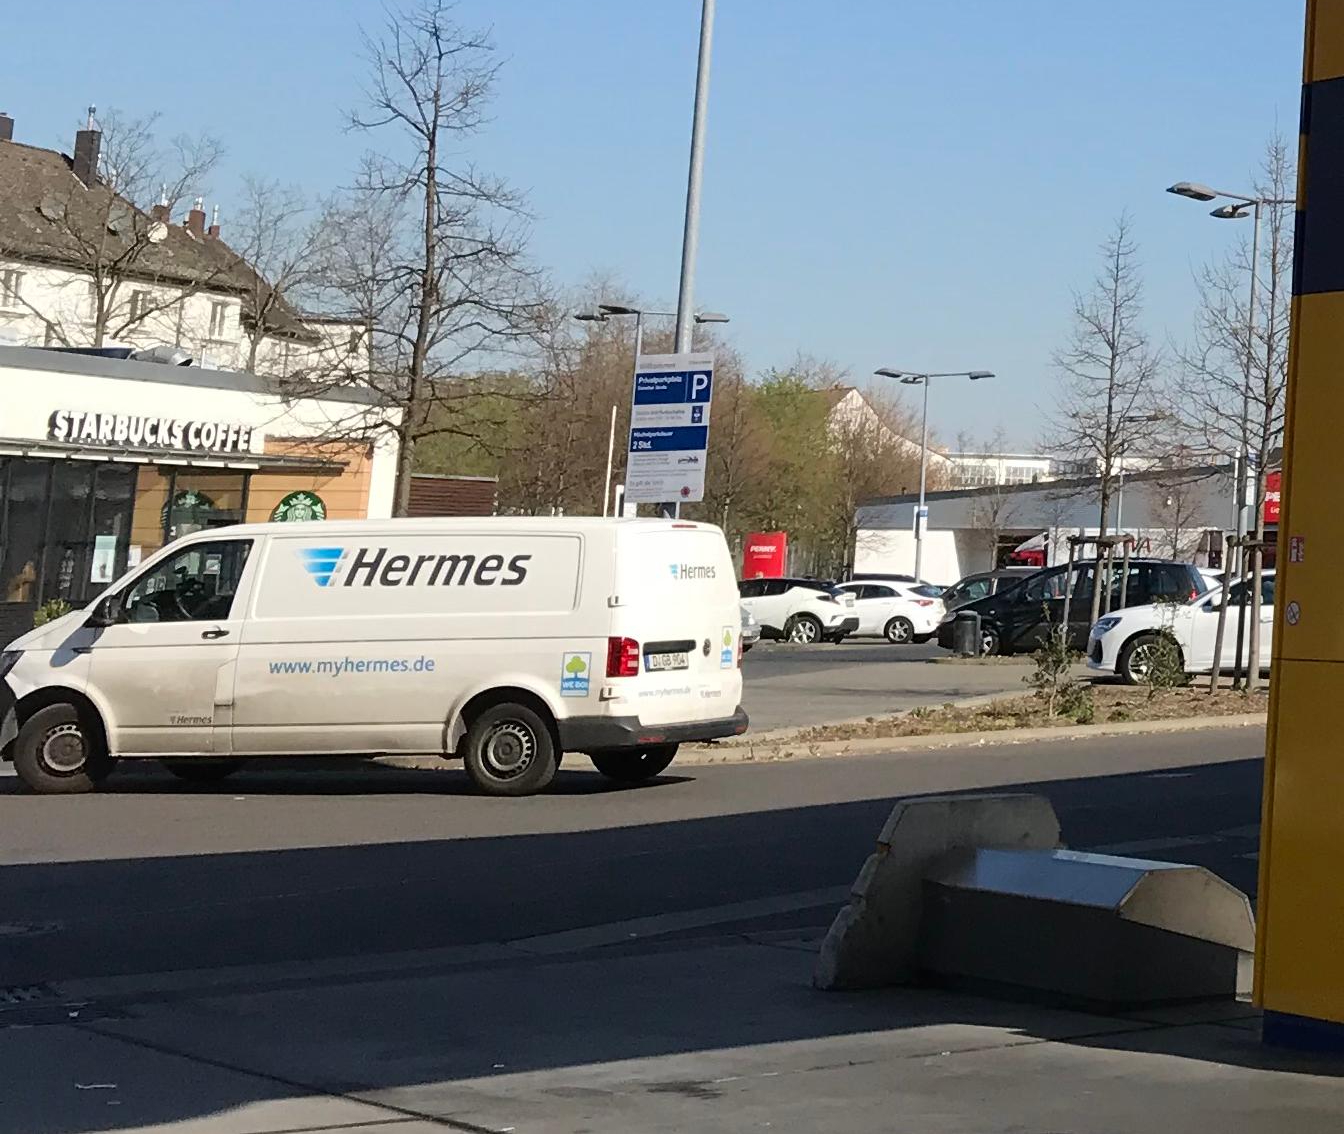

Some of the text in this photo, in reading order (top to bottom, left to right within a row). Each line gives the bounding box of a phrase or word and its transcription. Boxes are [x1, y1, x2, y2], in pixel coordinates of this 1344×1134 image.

[691, 374, 708, 400] P
[53, 409, 184, 449] STARBUCKS
[343, 547, 533, 587] Hermes
[680, 563, 716, 580] Hermes
[268, 655, 435, 678] www.myhermes.de
[176, 715, 213, 725] Hermes
